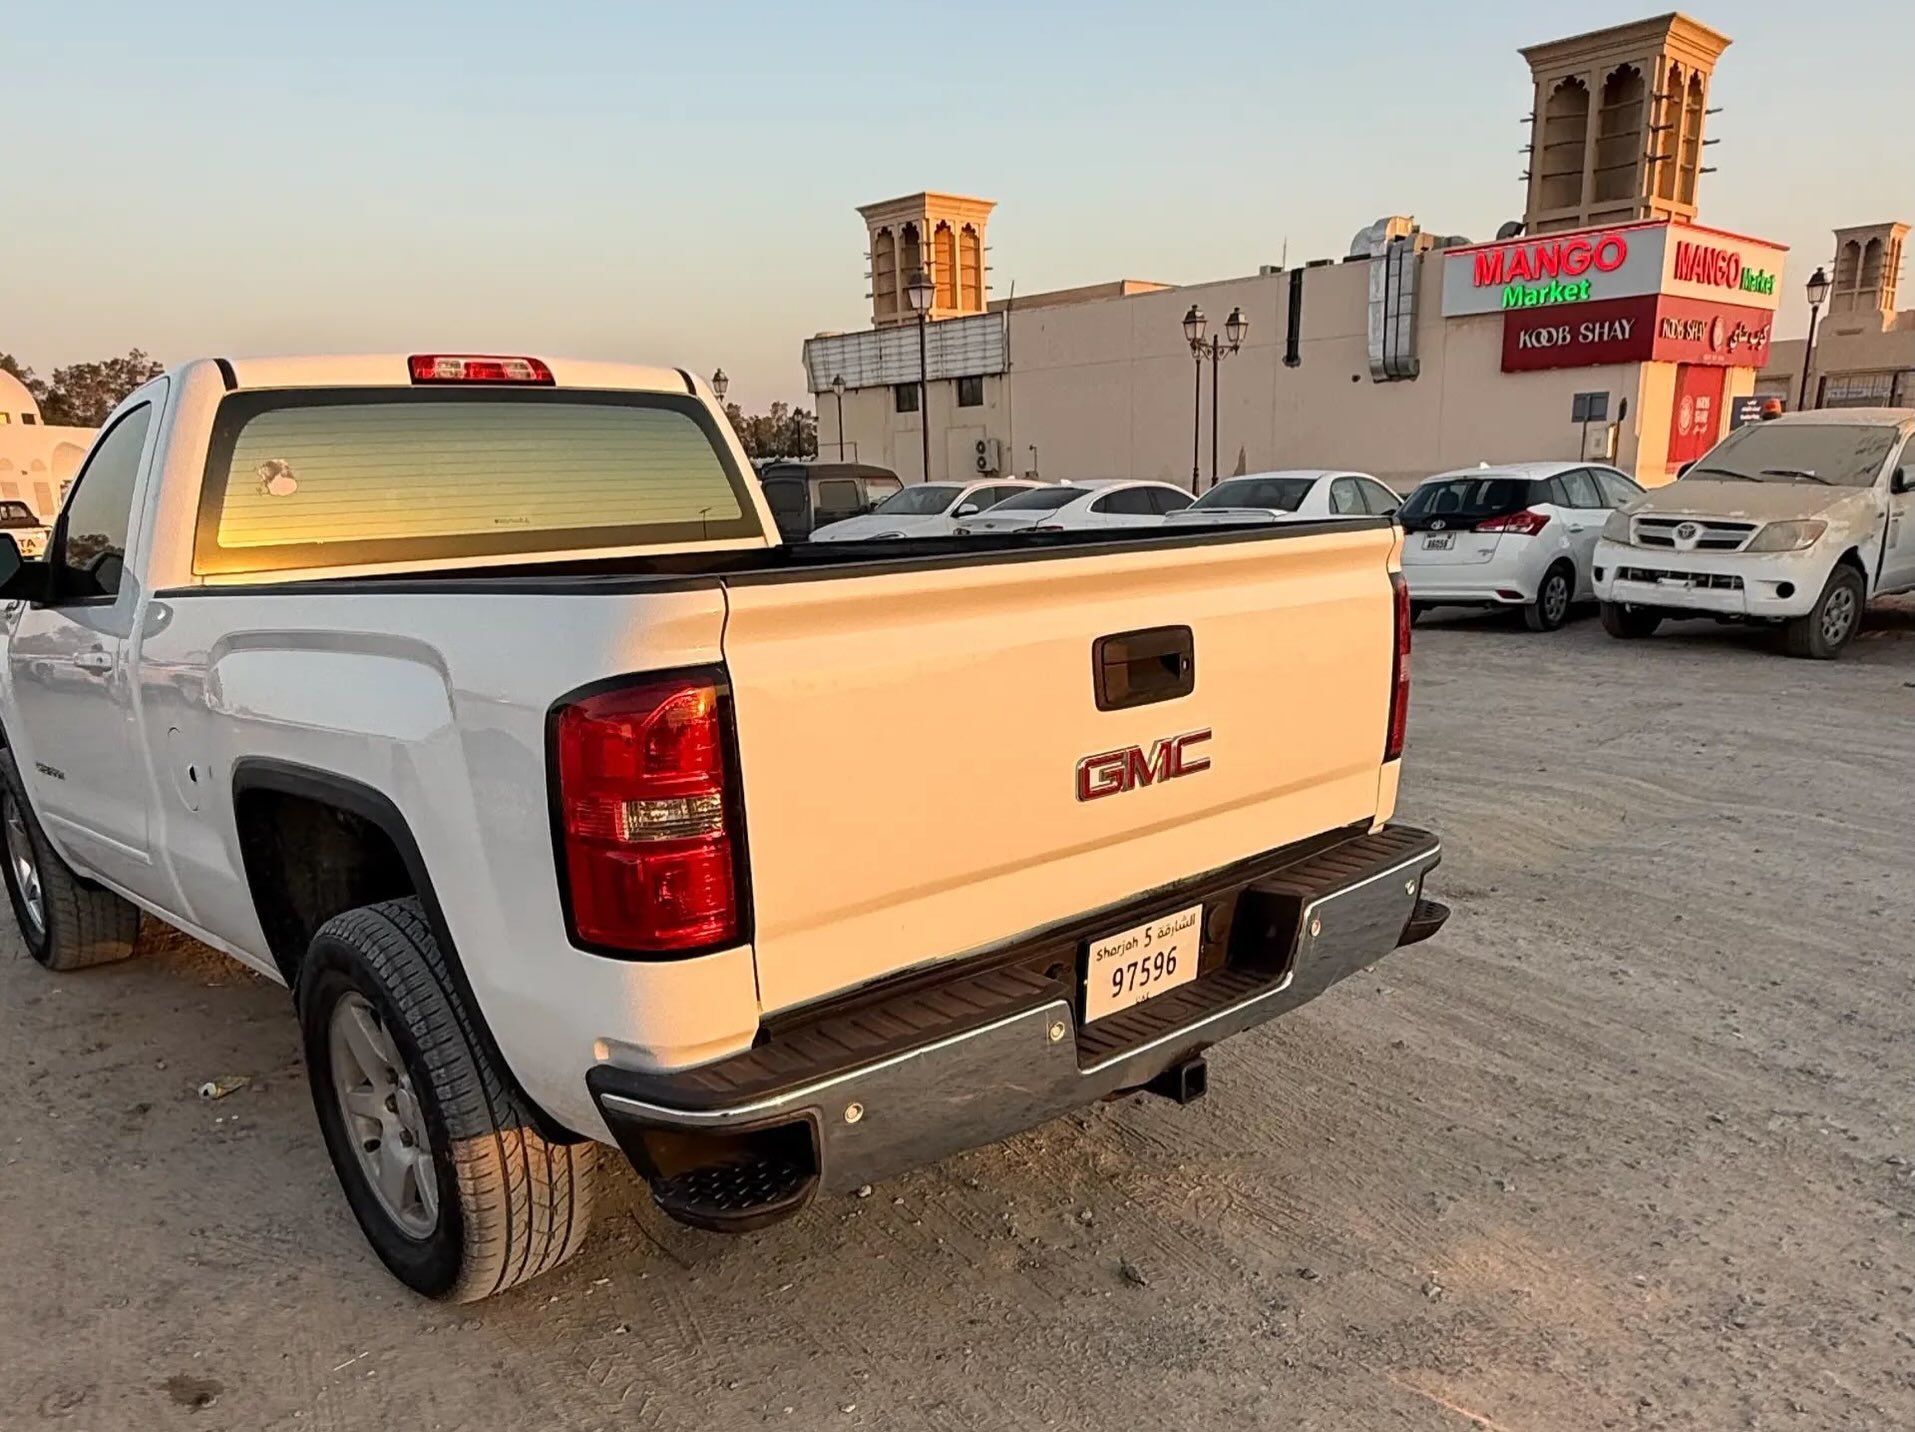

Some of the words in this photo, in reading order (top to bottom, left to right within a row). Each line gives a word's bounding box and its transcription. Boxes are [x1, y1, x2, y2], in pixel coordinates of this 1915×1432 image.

[1473, 233, 1627, 288] MANGO
[1674, 240, 1740, 289] MANGO
[1740, 266, 1776, 296] Market
[1503, 279, 1591, 309] Market
[1518, 325, 1571, 349] KOOB
[1578, 318, 1635, 343] SHAY
[1685, 319, 1707, 342] SHAY
[1076, 727, 1212, 802] GMC
[1096, 936, 1139, 961] Sharjah
[1144, 926, 1153, 948] 5
[1157, 913, 1196, 939] الشارقة
[1112, 946, 1177, 998] 97596
